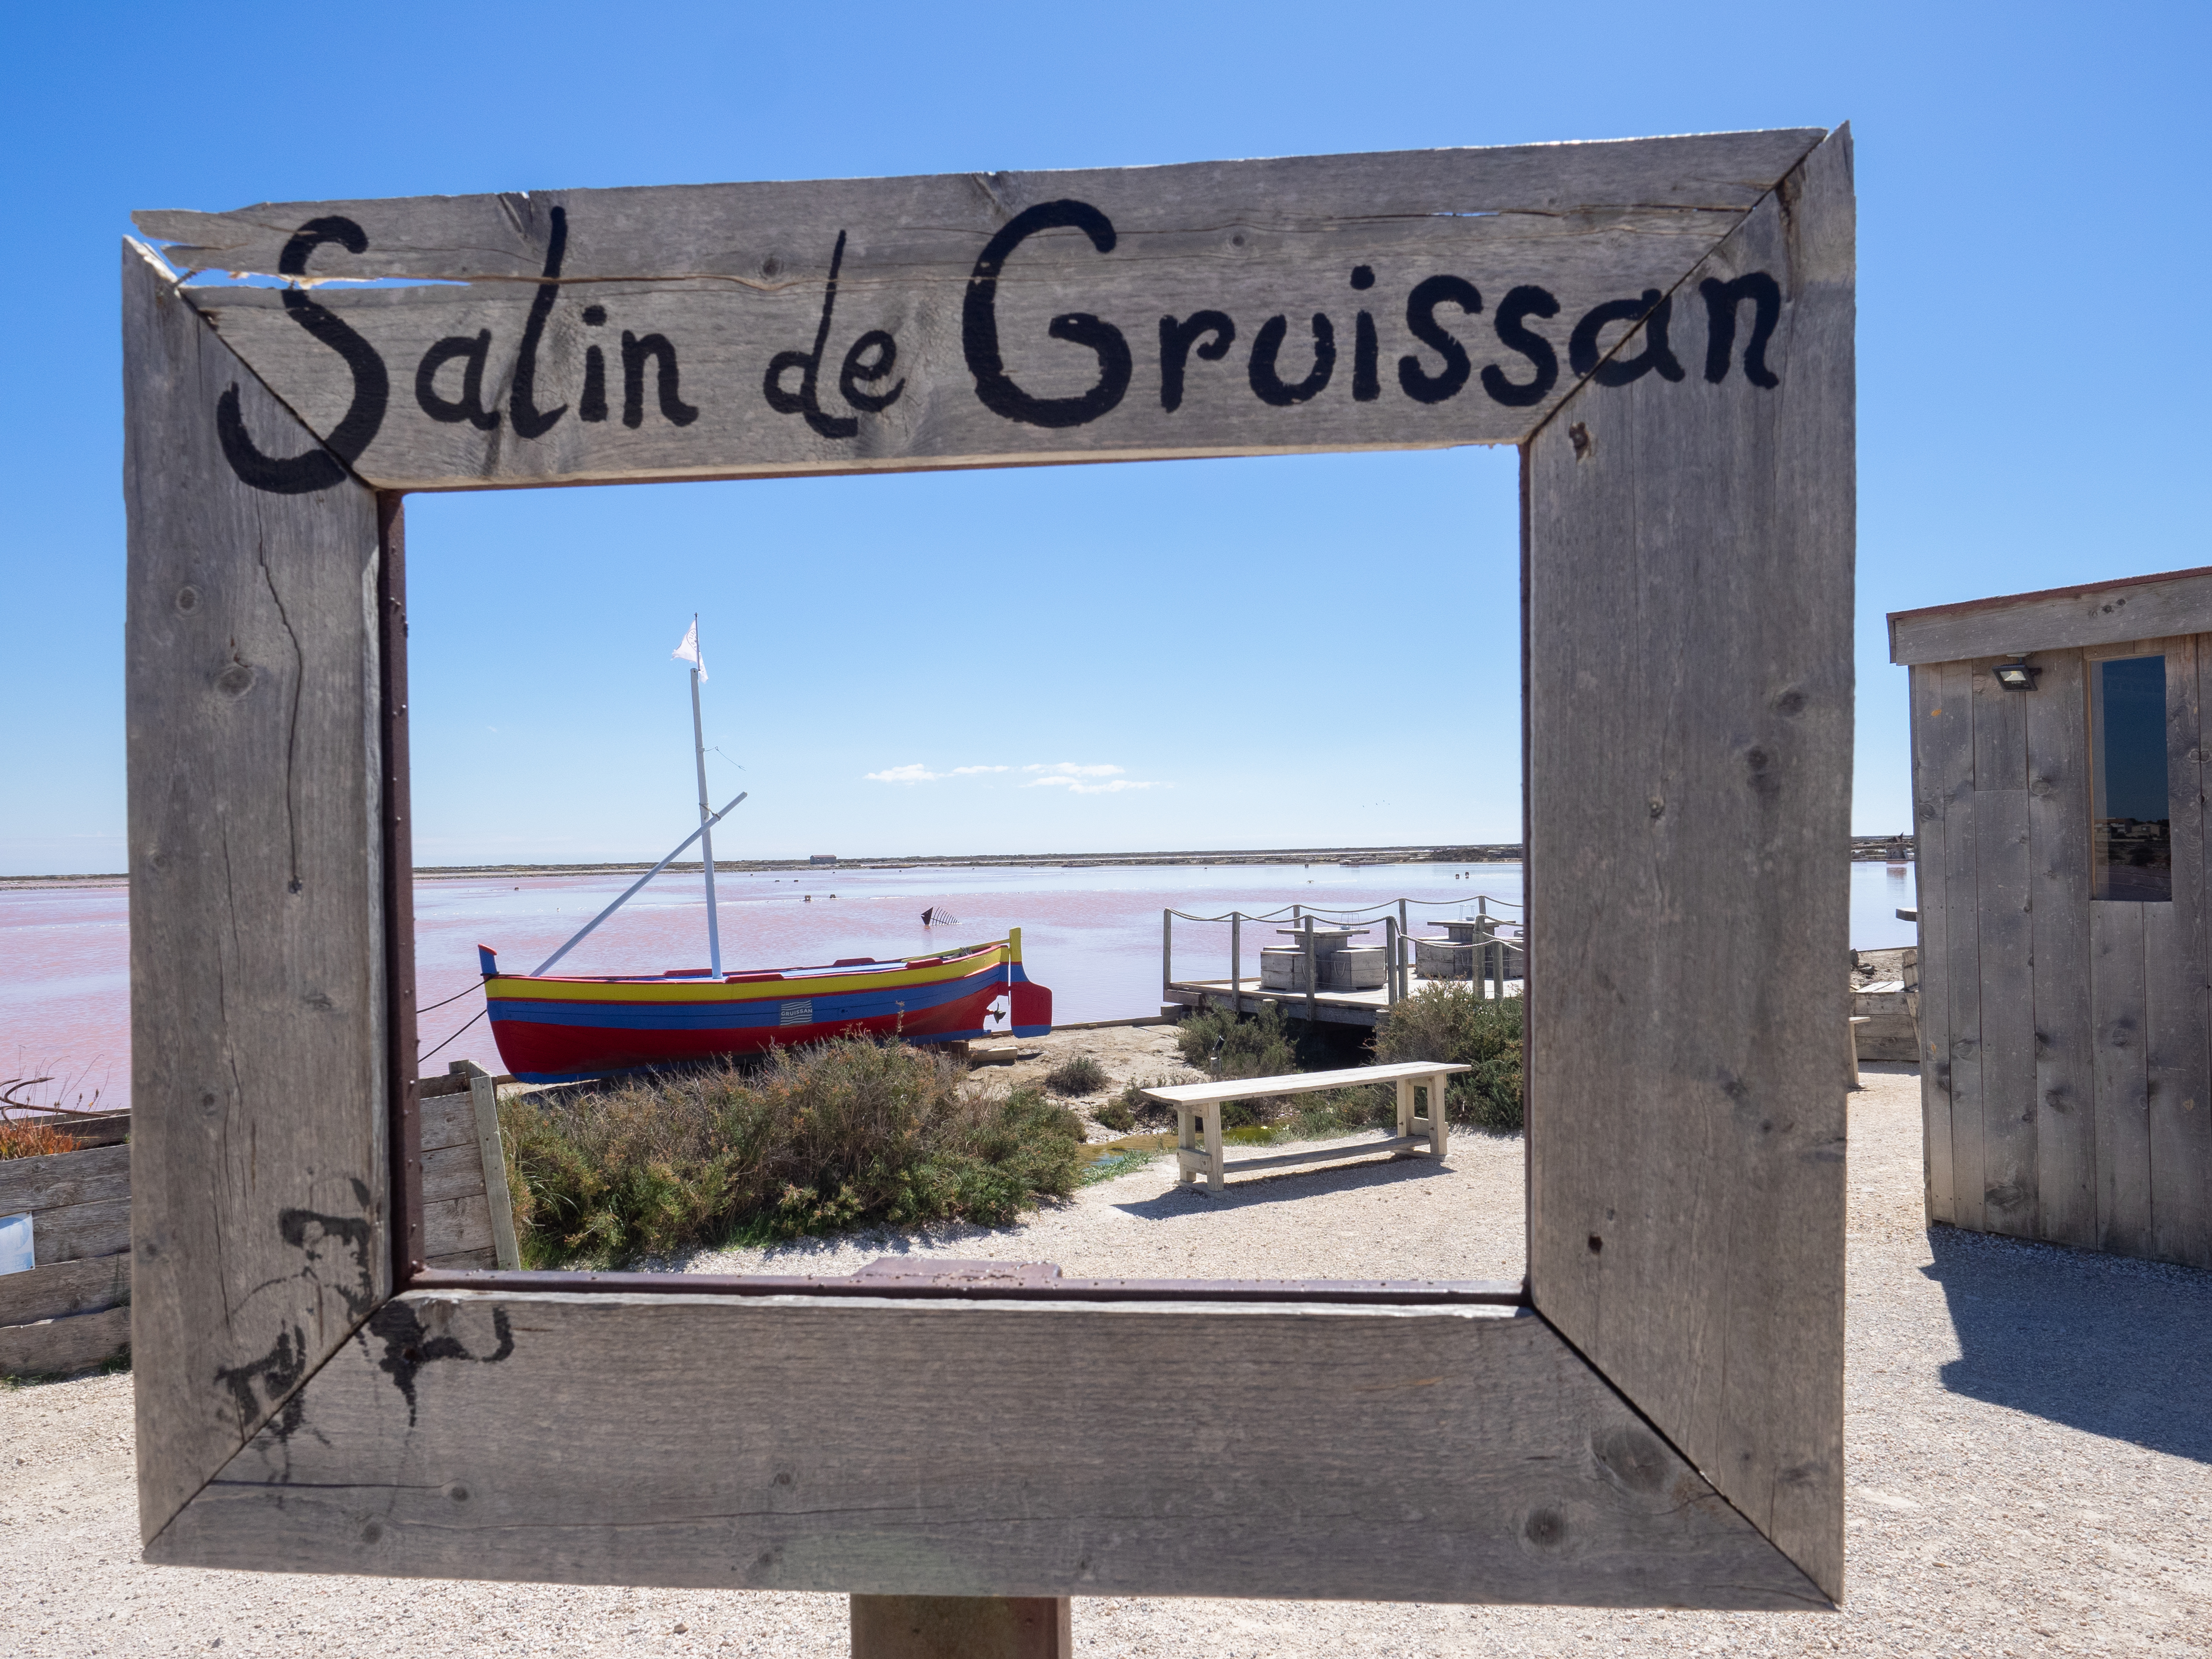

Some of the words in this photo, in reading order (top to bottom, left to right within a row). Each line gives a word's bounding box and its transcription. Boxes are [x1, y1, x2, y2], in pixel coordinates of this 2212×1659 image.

[217, 206, 699, 494] Salin
[763, 229, 906, 439] de
[962, 198, 1781, 429] Gruissan
[781, 1008, 813, 1016] GRUISSAN
